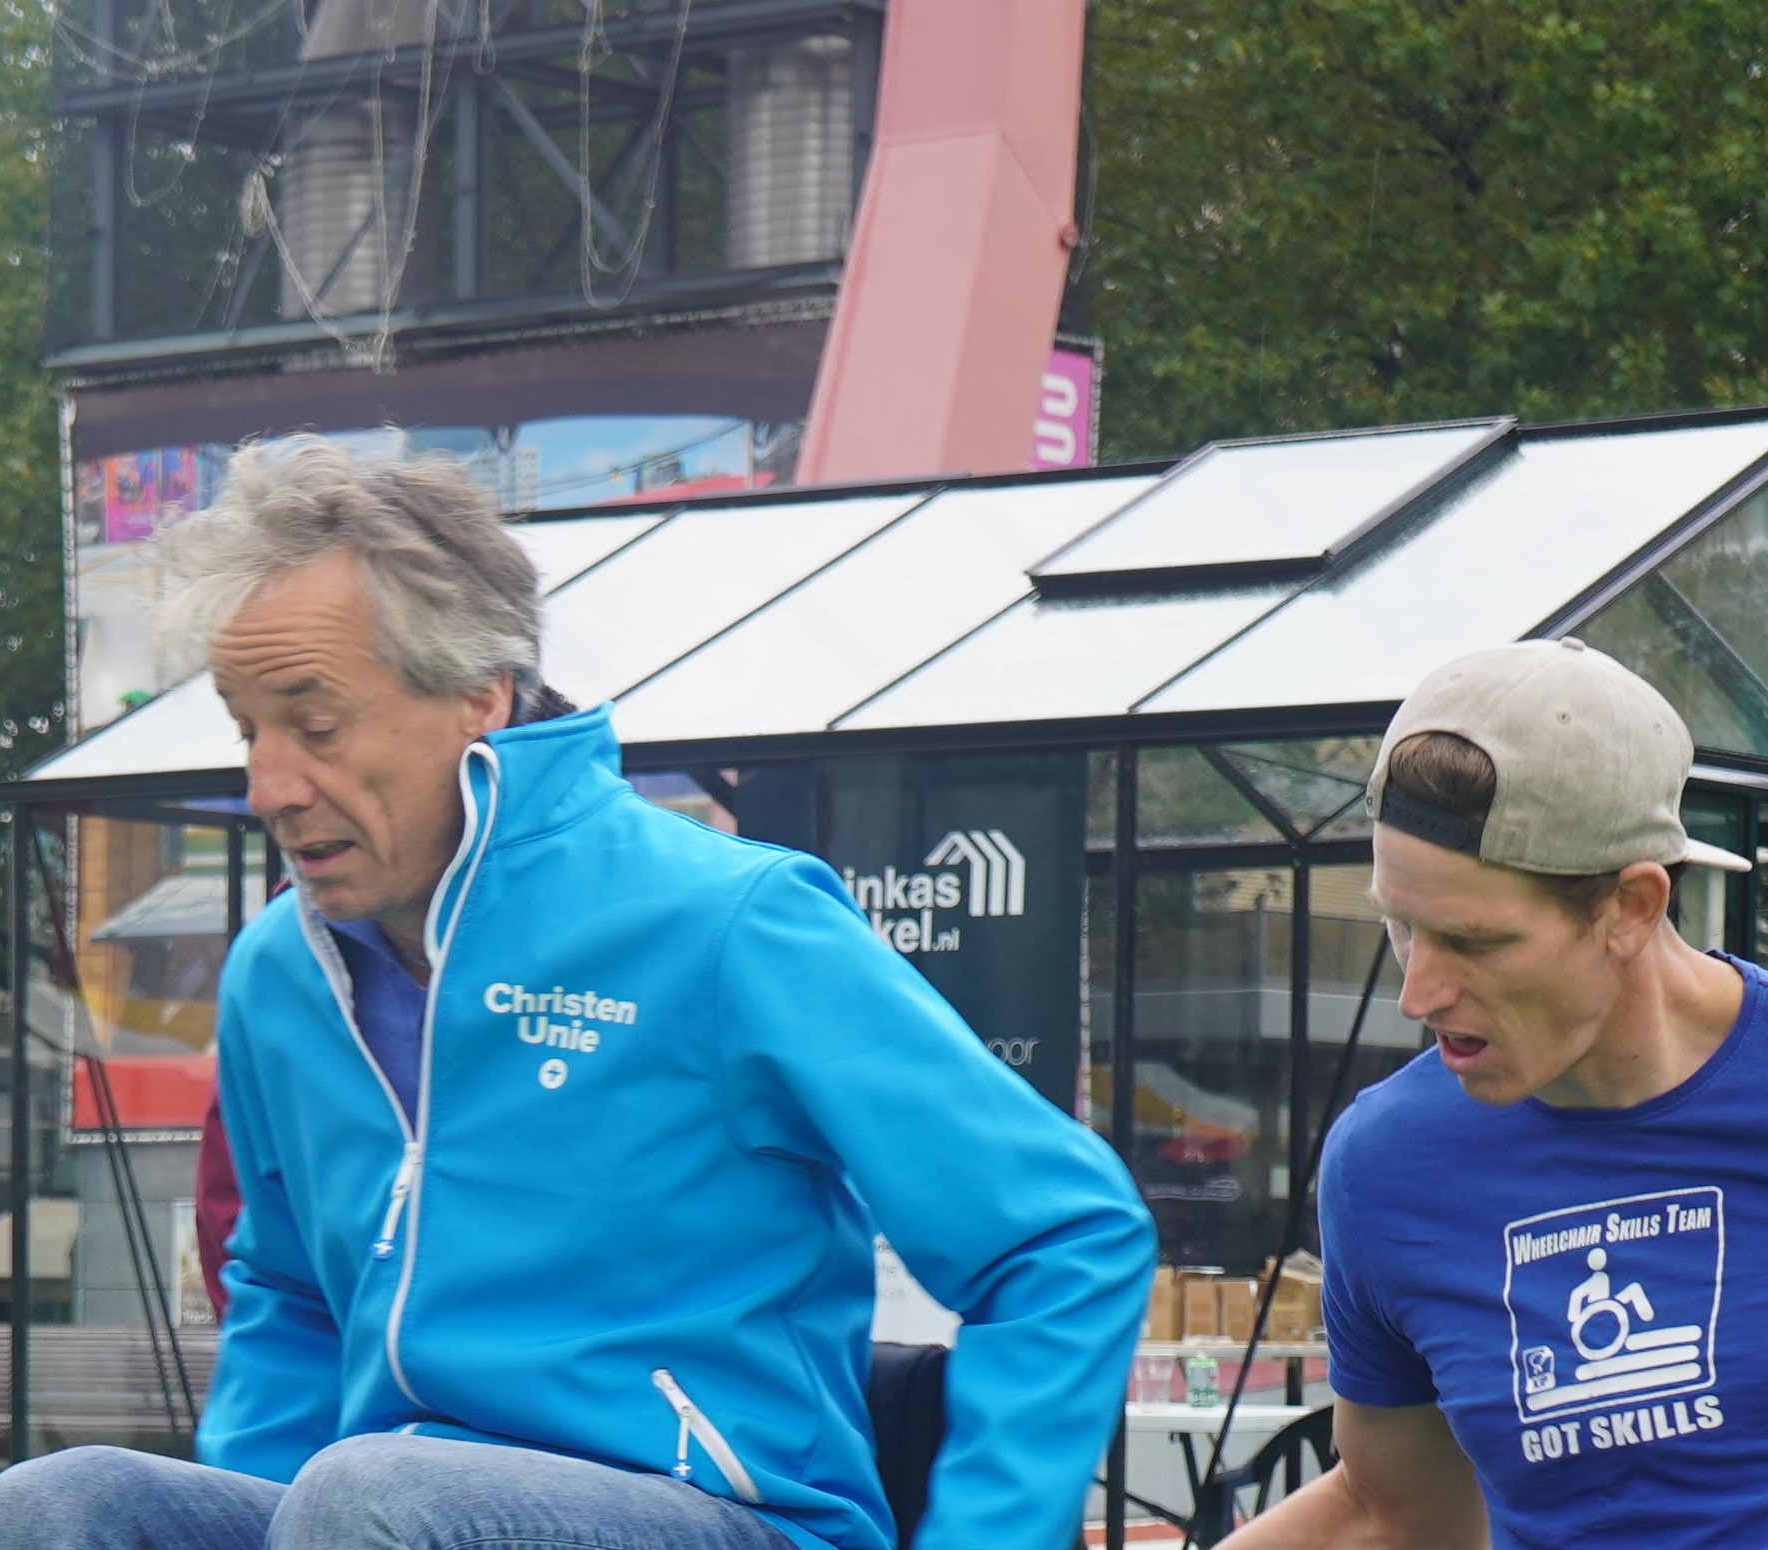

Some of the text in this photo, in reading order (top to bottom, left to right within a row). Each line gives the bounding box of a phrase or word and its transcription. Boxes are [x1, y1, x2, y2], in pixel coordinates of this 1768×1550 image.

[484, 982, 638, 1025] Christen
[517, 1016, 600, 1053] Unie
[987, 1037, 1039, 1066] oor
[1605, 1212, 1660, 1243] SKILLS
[1666, 1204, 1712, 1233] TEAM
[1521, 1395, 1724, 1462] GOT SKILLS
